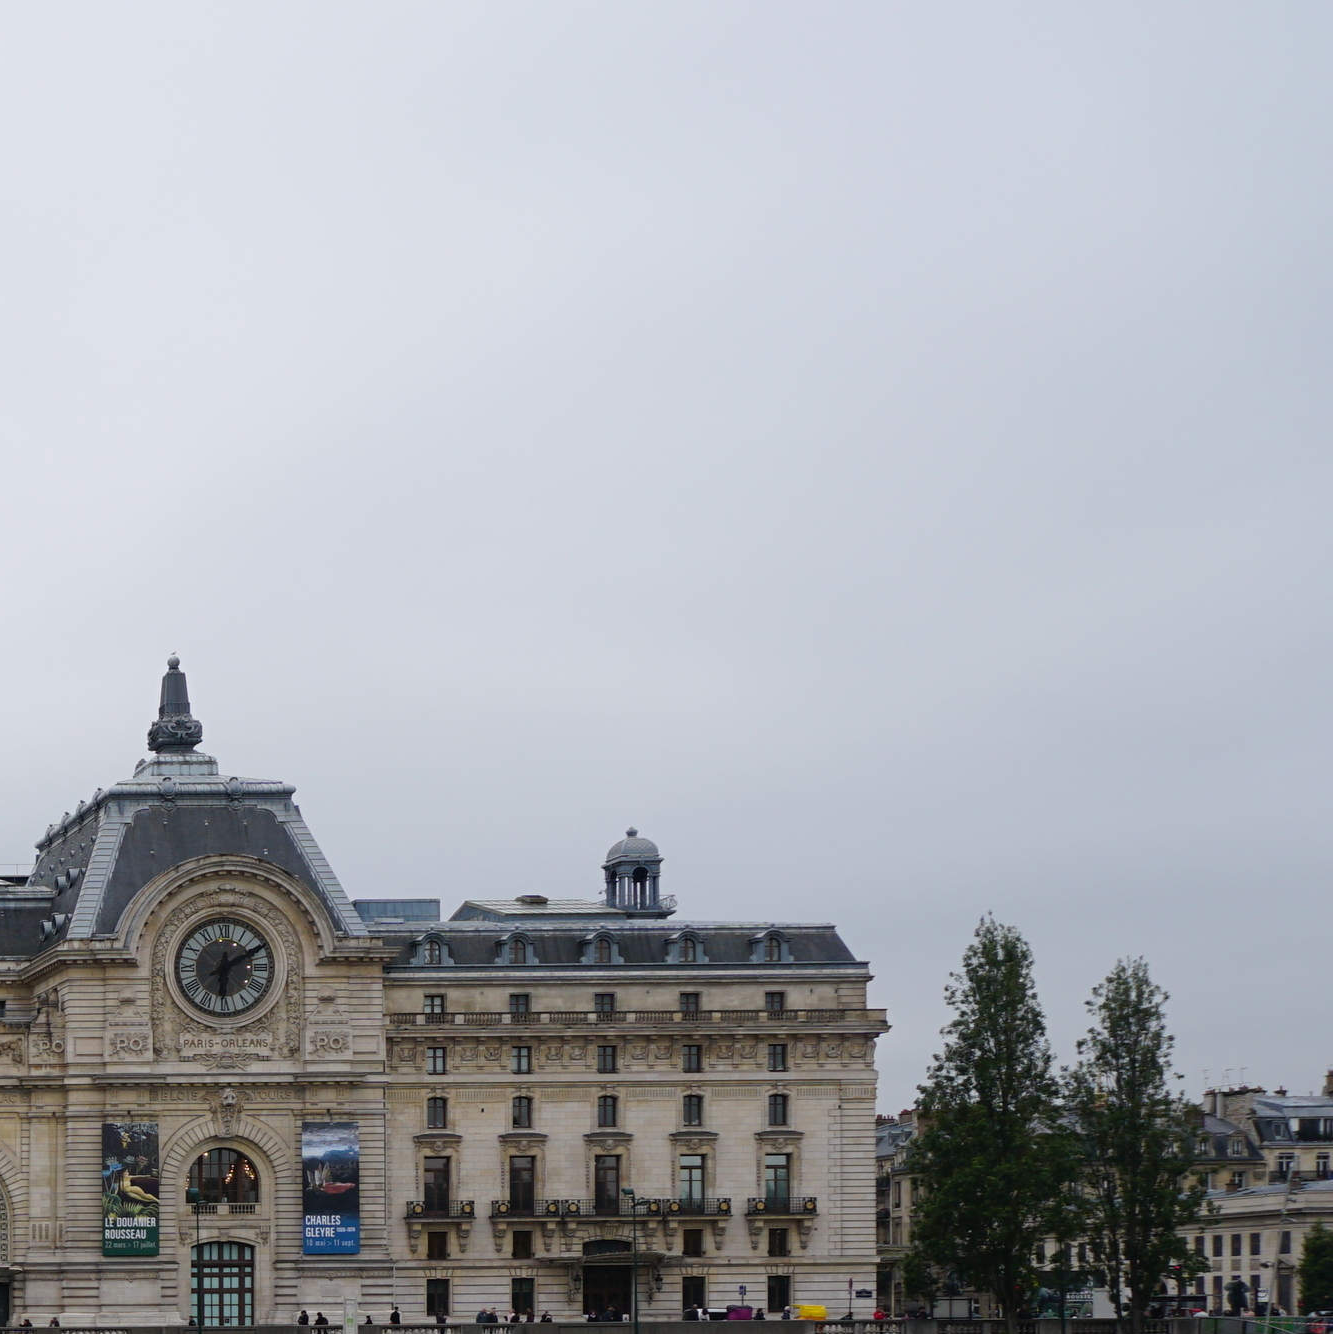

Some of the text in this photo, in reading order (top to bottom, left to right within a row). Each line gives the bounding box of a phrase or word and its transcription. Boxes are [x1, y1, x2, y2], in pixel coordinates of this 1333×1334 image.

[199, 929, 212, 944] XI
[218, 925, 230, 938] XII
[239, 930, 246, 942] I
[185, 944, 200, 955] X
[39, 1041, 64, 1052] PO
[116, 1038, 142, 1050] PO
[184, 1038, 268, 1048] PARIS-ORLEANS
[317, 1037, 342, 1049] PO
[252, 1090, 292, 1100] TOURS
[105, 1218, 156, 1227] LE DOUANIER
[306, 1215, 340, 1225] CHARLES
[105, 1229, 146, 1239] ROUSSEAU
[306, 1227, 335, 1237] GLEYRE
